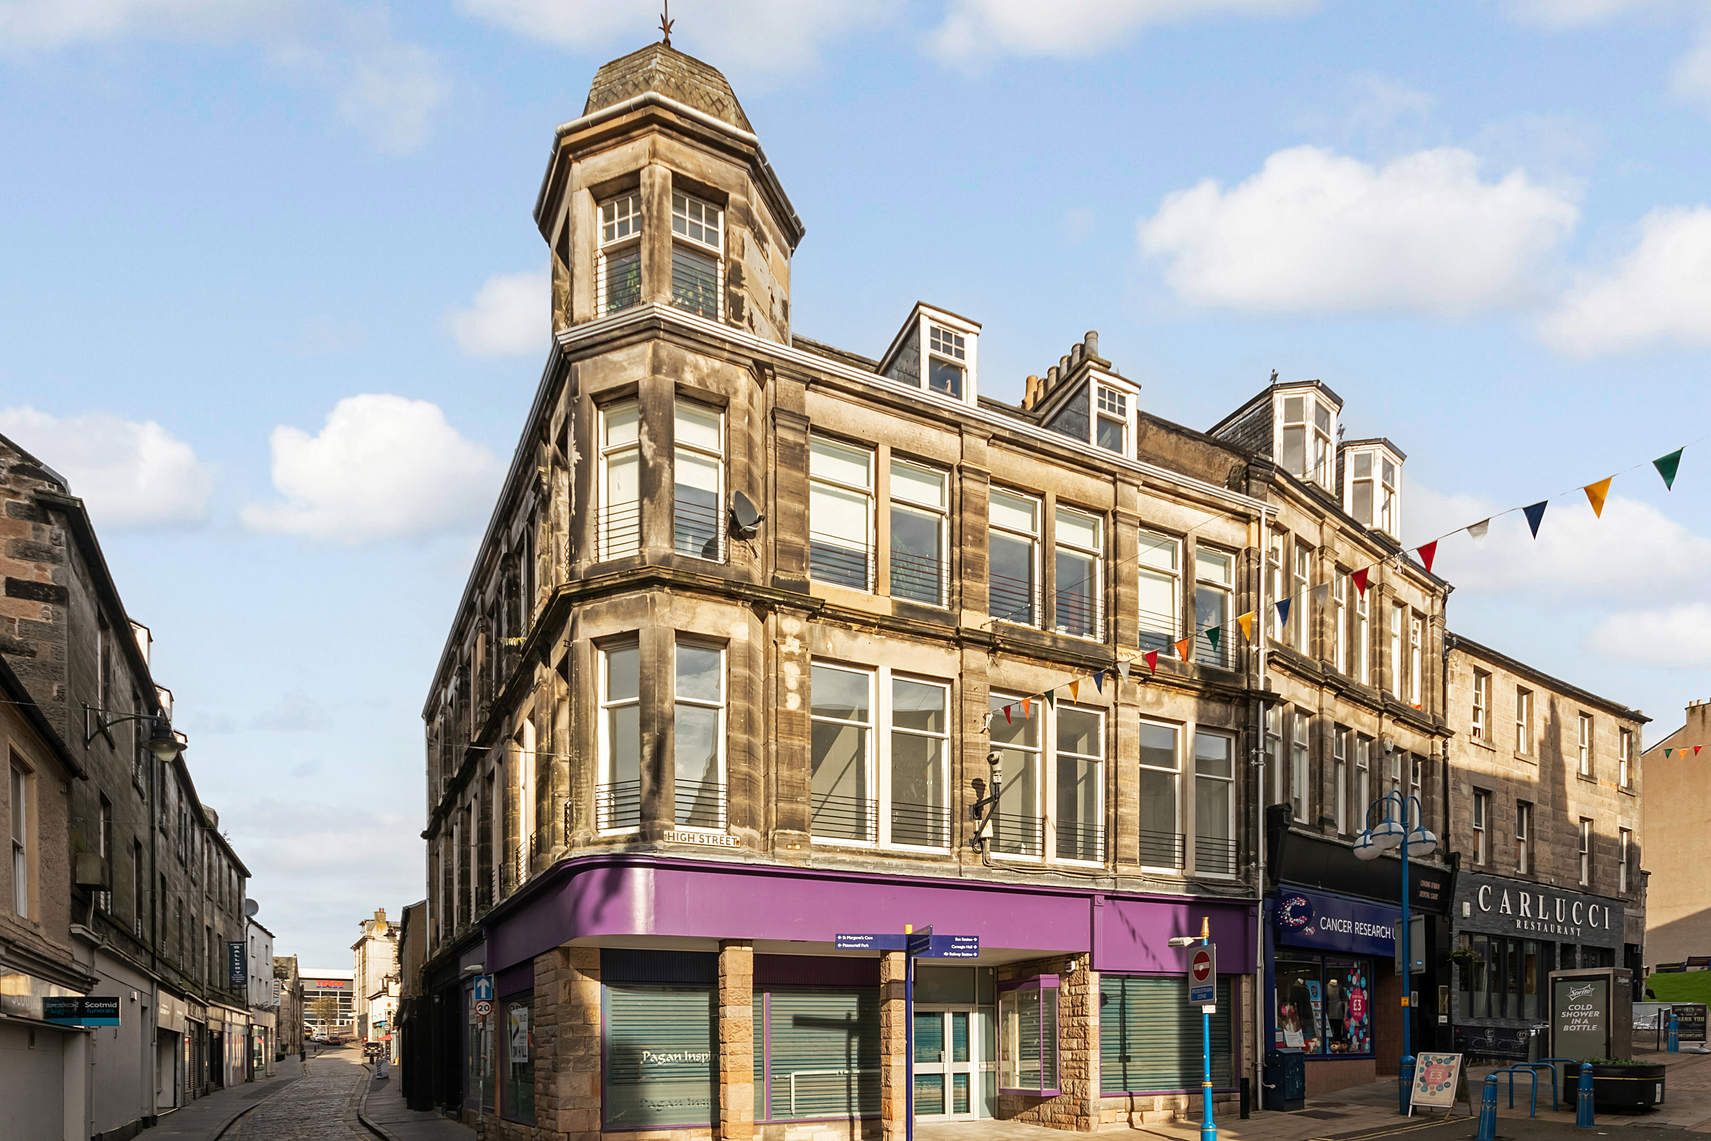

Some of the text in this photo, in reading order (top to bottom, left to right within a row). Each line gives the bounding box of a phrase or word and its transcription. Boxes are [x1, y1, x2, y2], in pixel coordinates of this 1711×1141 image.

[667, 832, 737, 846] HIGH STREET
[1478, 884, 1609, 930] CARLUCCI
[1320, 917, 1352, 934] CANCER
[1355, 923, 1391, 938] RESEARCH
[1516, 919, 1581, 937] RESTAURANT
[84, 1001, 118, 1009] Scotmid
[478, 1004, 490, 1012] 20
[1353, 999, 1362, 1011] £3
[641, 1050, 682, 1066] Pagan
